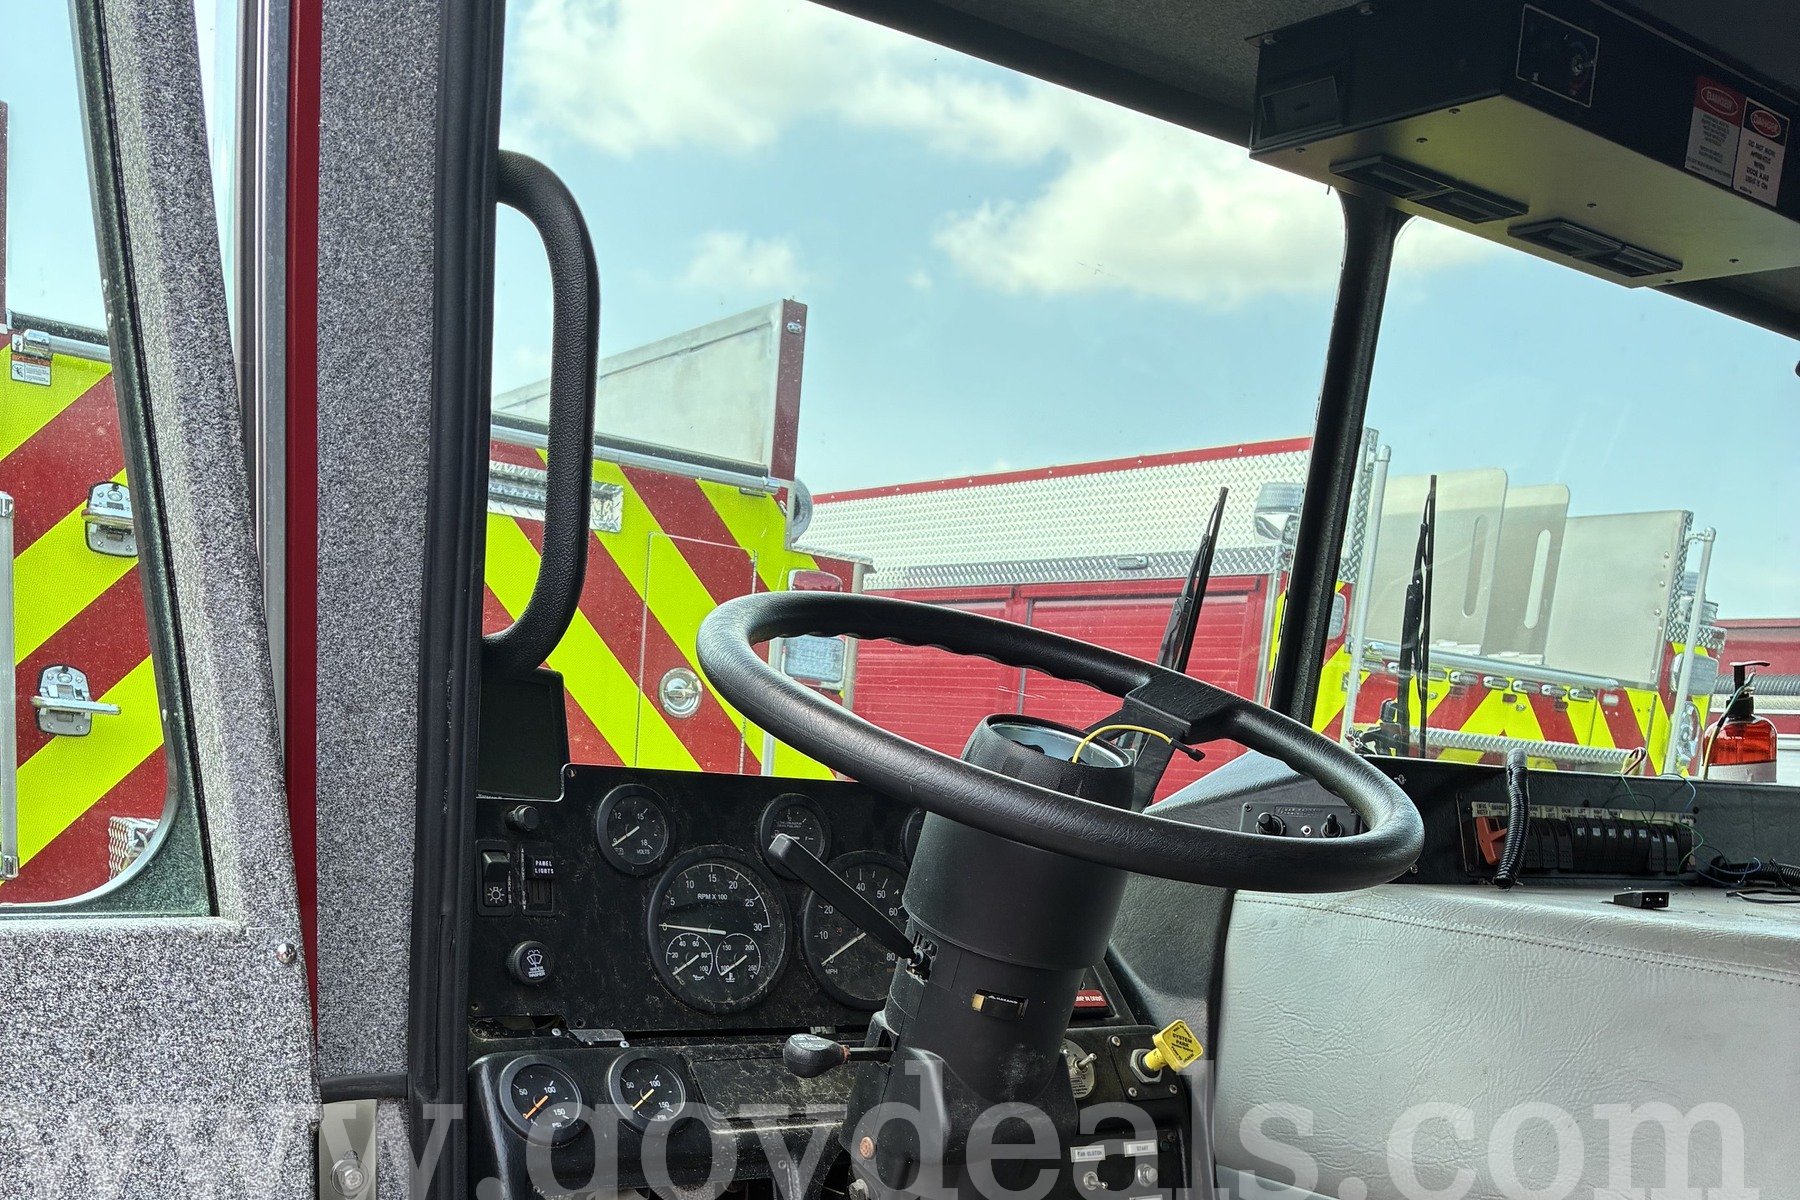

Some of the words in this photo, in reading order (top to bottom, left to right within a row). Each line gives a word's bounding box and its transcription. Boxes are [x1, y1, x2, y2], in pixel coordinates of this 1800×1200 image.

[614, 812, 622, 820] 12
[637, 812, 644, 820] 15
[708, 874, 717, 882] 15
[686, 880, 694, 888] 10
[728, 881, 738, 889] 20
[856, 883, 866, 891] 40
[876, 890, 886, 898] 50
[824, 906, 833, 914] 20
[889, 908, 898, 916] 60
[754, 923, 762, 931] 30
[819, 931, 828, 939] 10
[887, 953, 895, 961] 80
[1172, 1033, 1192, 1043] SYSTEM
[626, 1081, 635, 1089] 50
[519, 1088, 528, 1096] 50
[544, 1086, 556, 1094] 100
[658, 1101, 670, 1110] 150
[553, 1108, 566, 1116] 150
